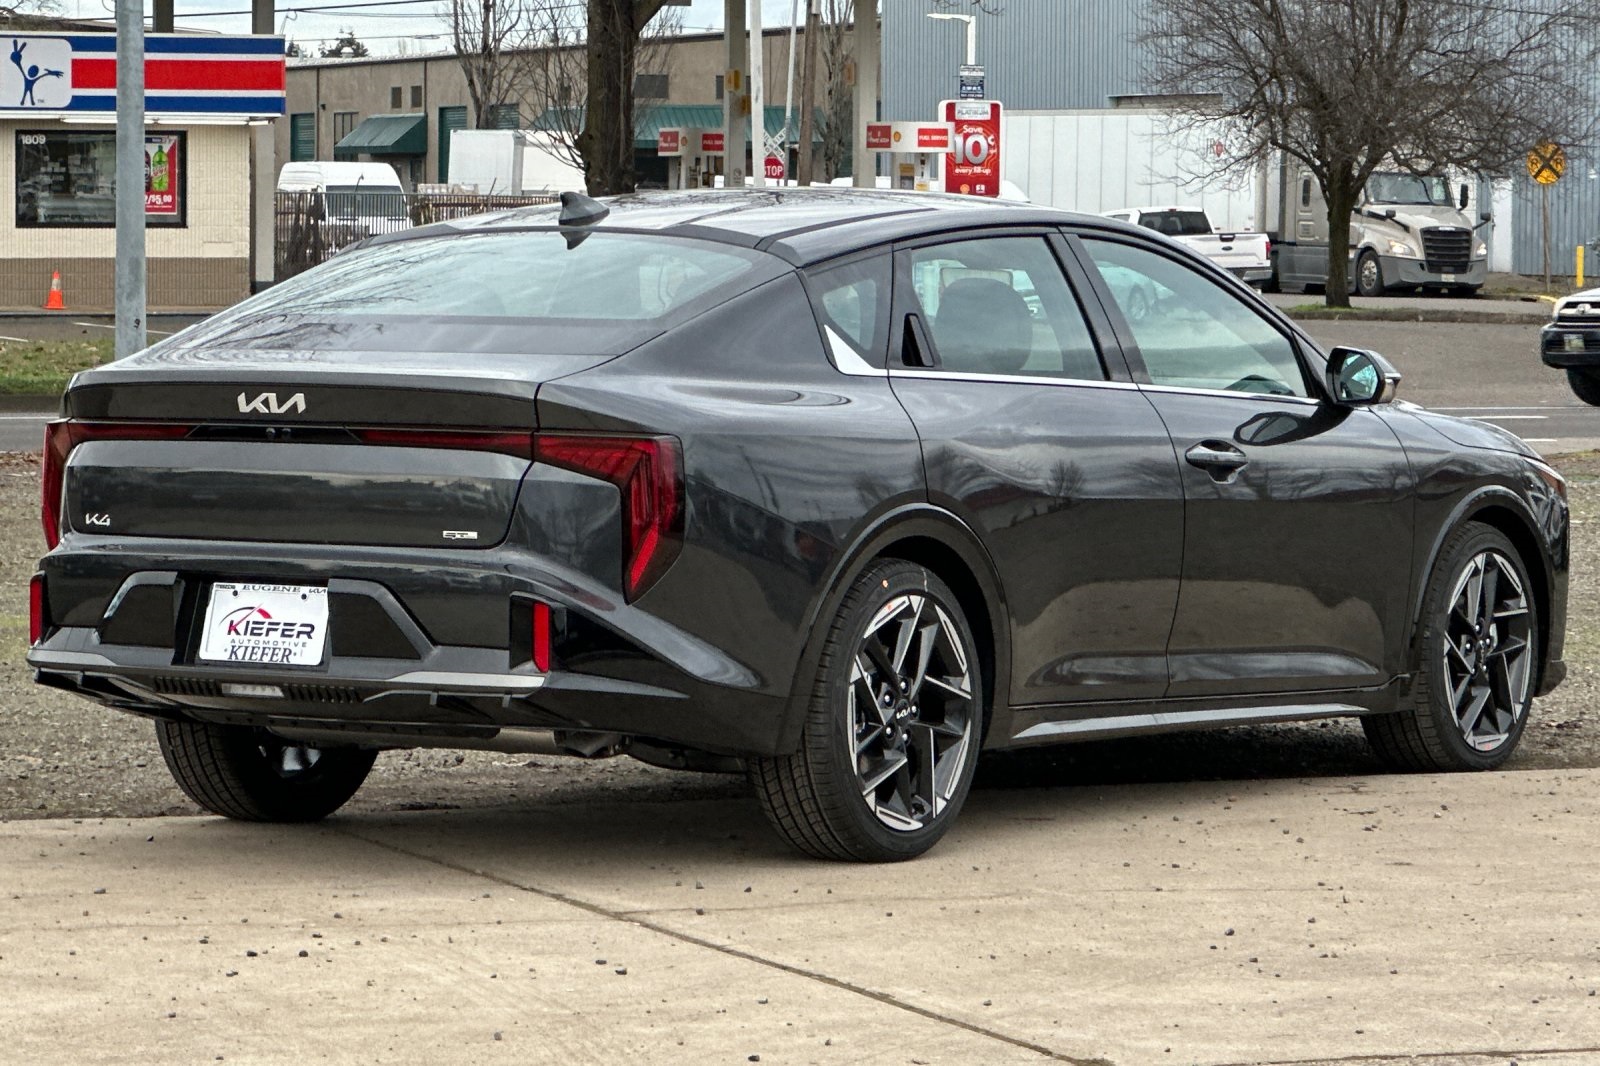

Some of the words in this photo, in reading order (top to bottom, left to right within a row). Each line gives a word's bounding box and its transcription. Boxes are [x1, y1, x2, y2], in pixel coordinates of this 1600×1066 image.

[962, 124, 984, 134] Save
[21, 133, 46, 145] 1809
[764, 165, 784, 177] TOP
[237, 392, 306, 414] KIA
[85, 513, 110, 527] K4
[242, 584, 301, 592] EUGENE
[227, 620, 315, 639] KIEFER
[230, 638, 307, 648] AUTOMOTIVE
[228, 645, 292, 663] KIEFER
